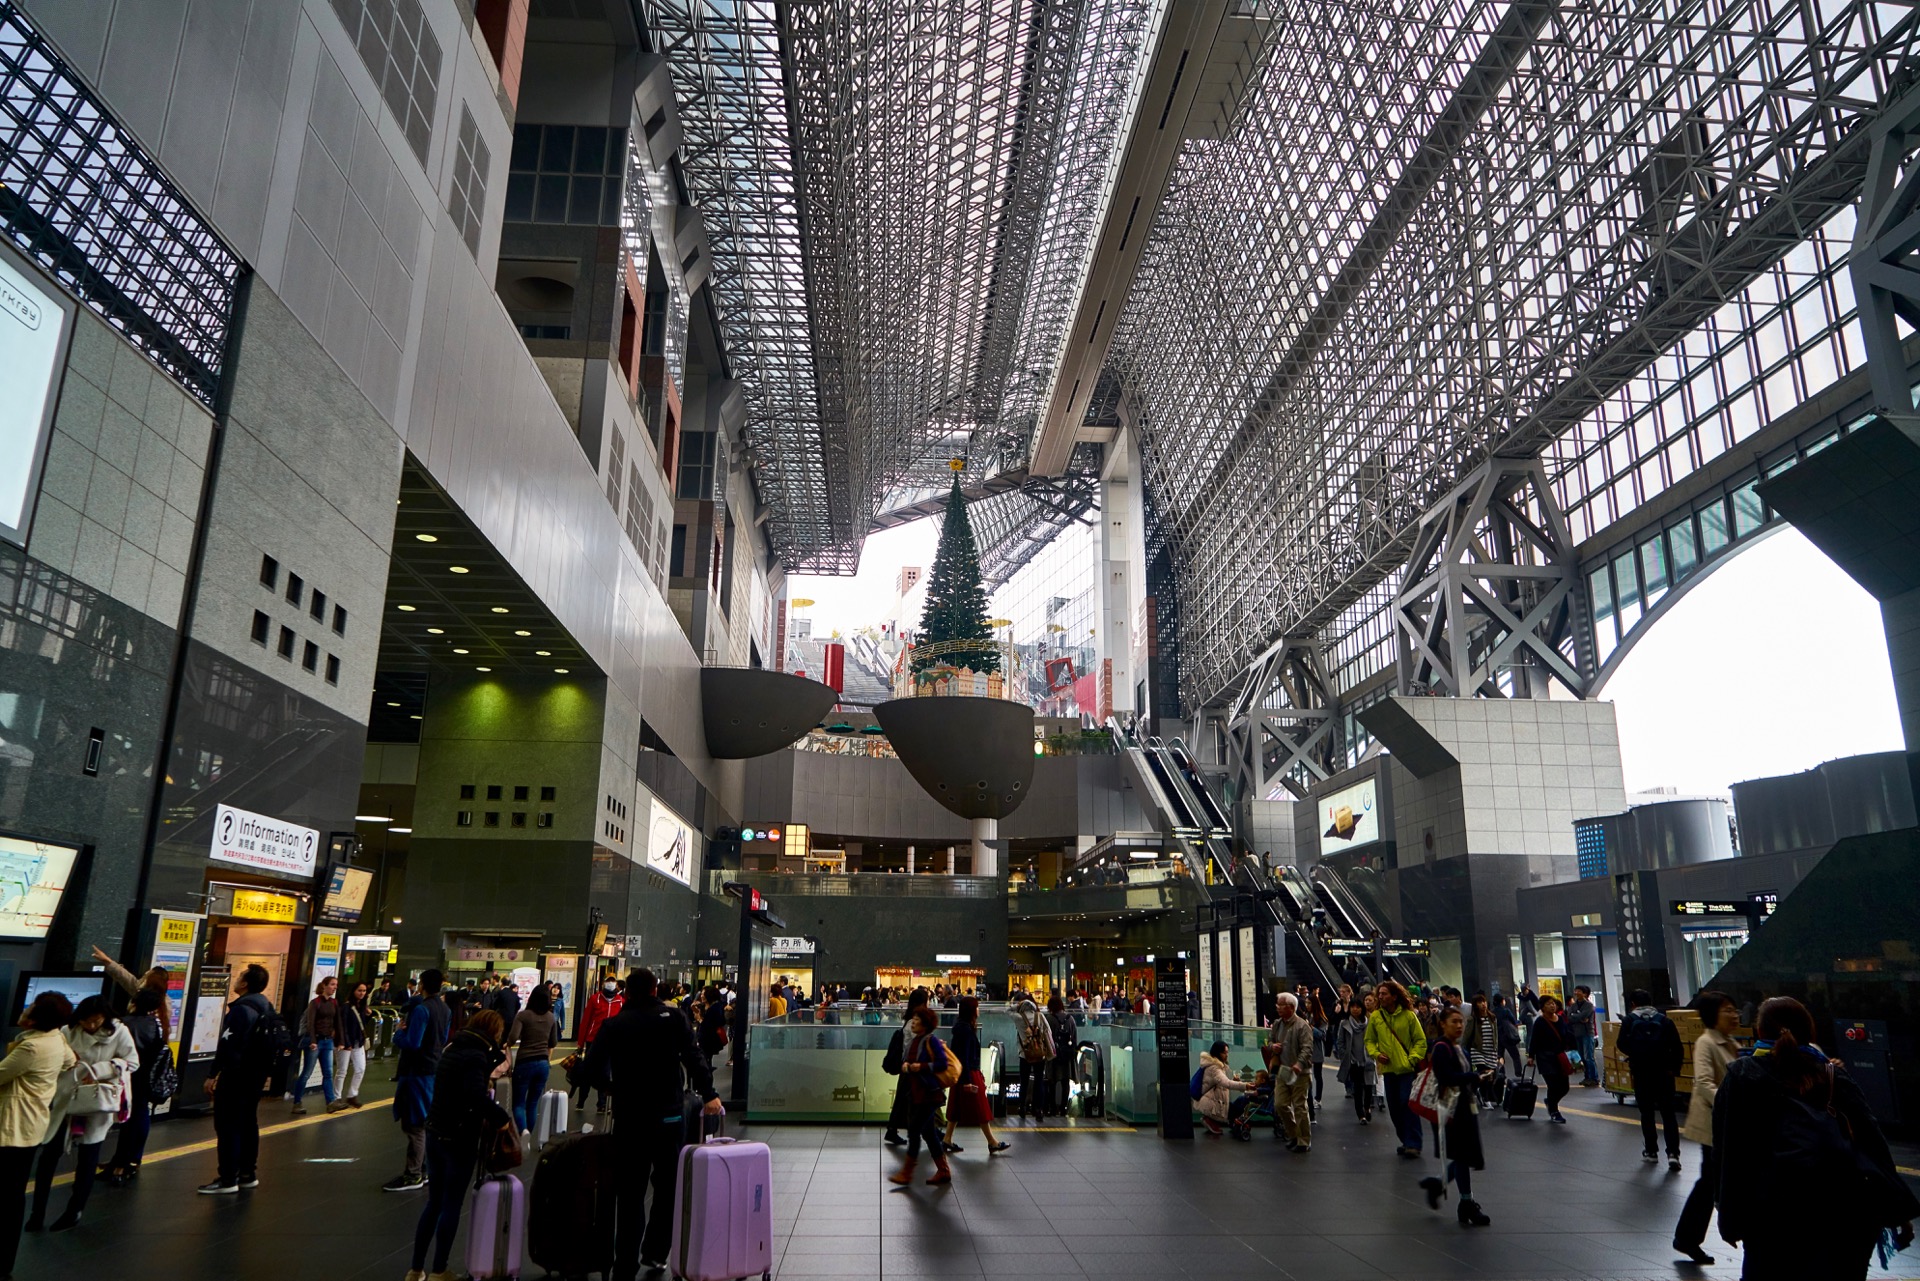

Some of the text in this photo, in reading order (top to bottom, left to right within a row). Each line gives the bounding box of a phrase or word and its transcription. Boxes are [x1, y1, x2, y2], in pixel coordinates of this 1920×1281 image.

[0, 286, 37, 321] rkray
[239, 817, 300, 847] Information
[167, 922, 188, 932] 海外の方
